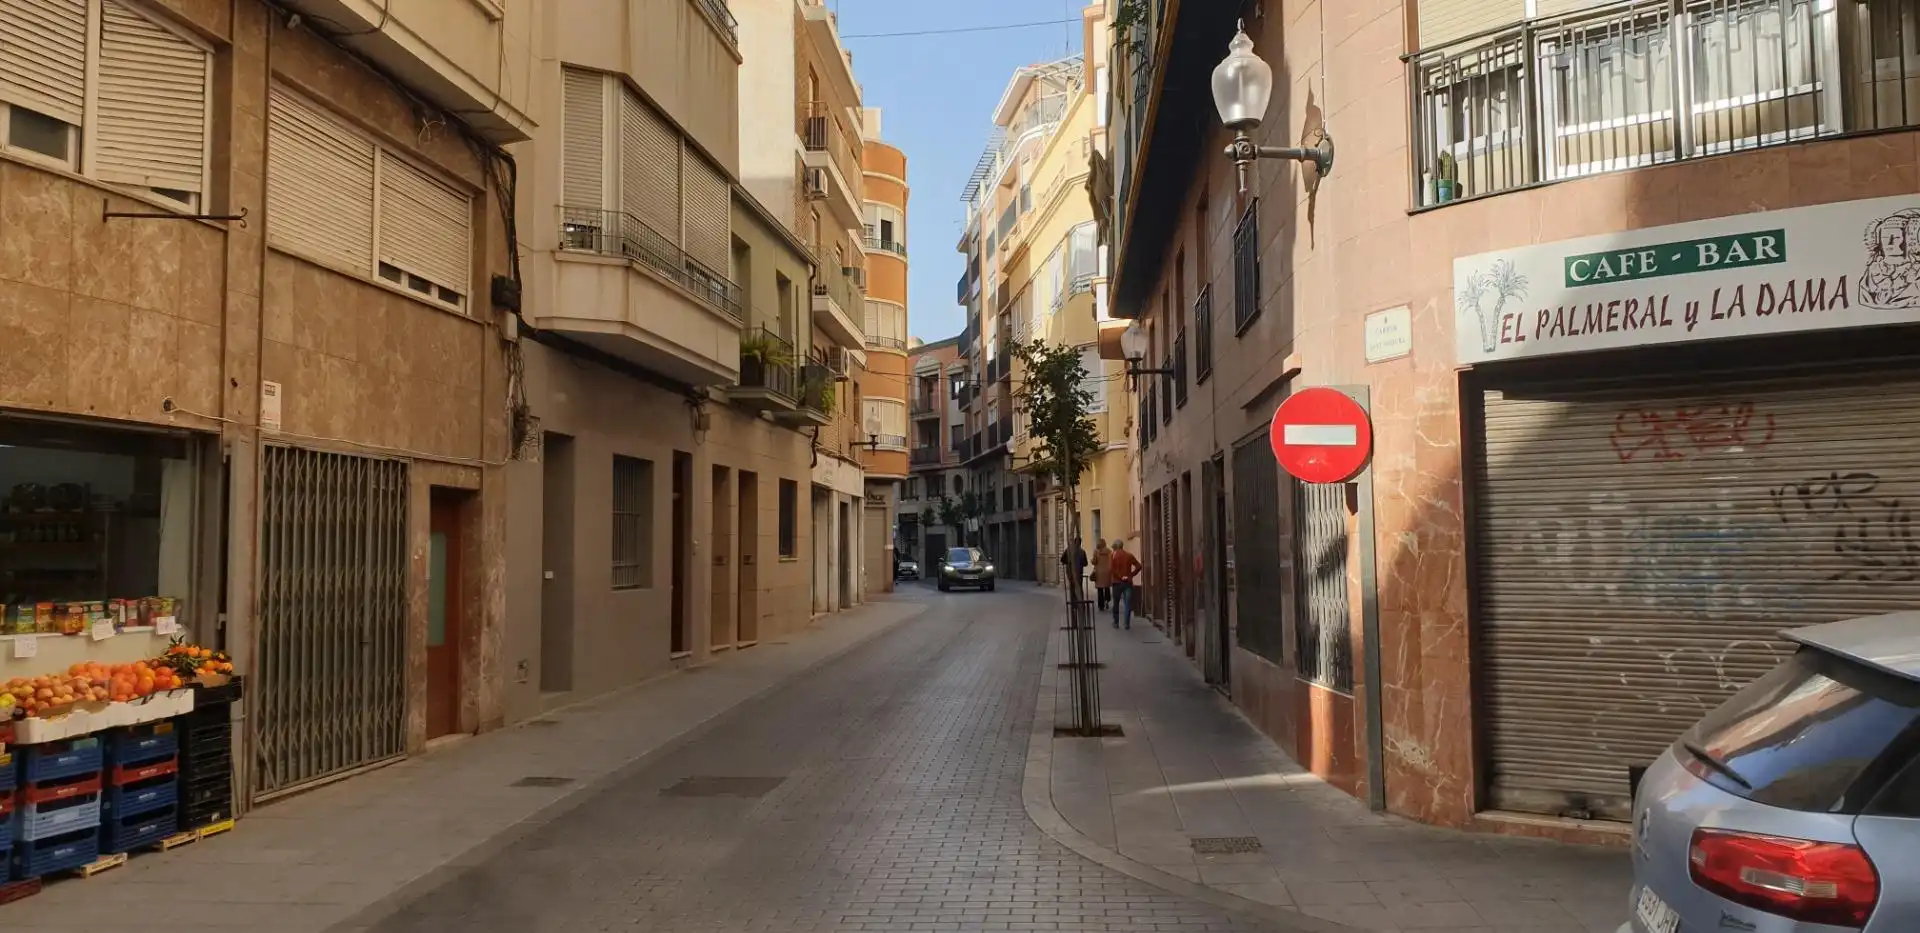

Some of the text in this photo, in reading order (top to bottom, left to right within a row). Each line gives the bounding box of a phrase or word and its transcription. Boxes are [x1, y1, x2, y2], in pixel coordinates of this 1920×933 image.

[1570, 251, 1657, 281] CAFE
[1697, 236, 1779, 267] BAR
[1501, 276, 1849, 344] EL PALMERAL y LA DAMA
